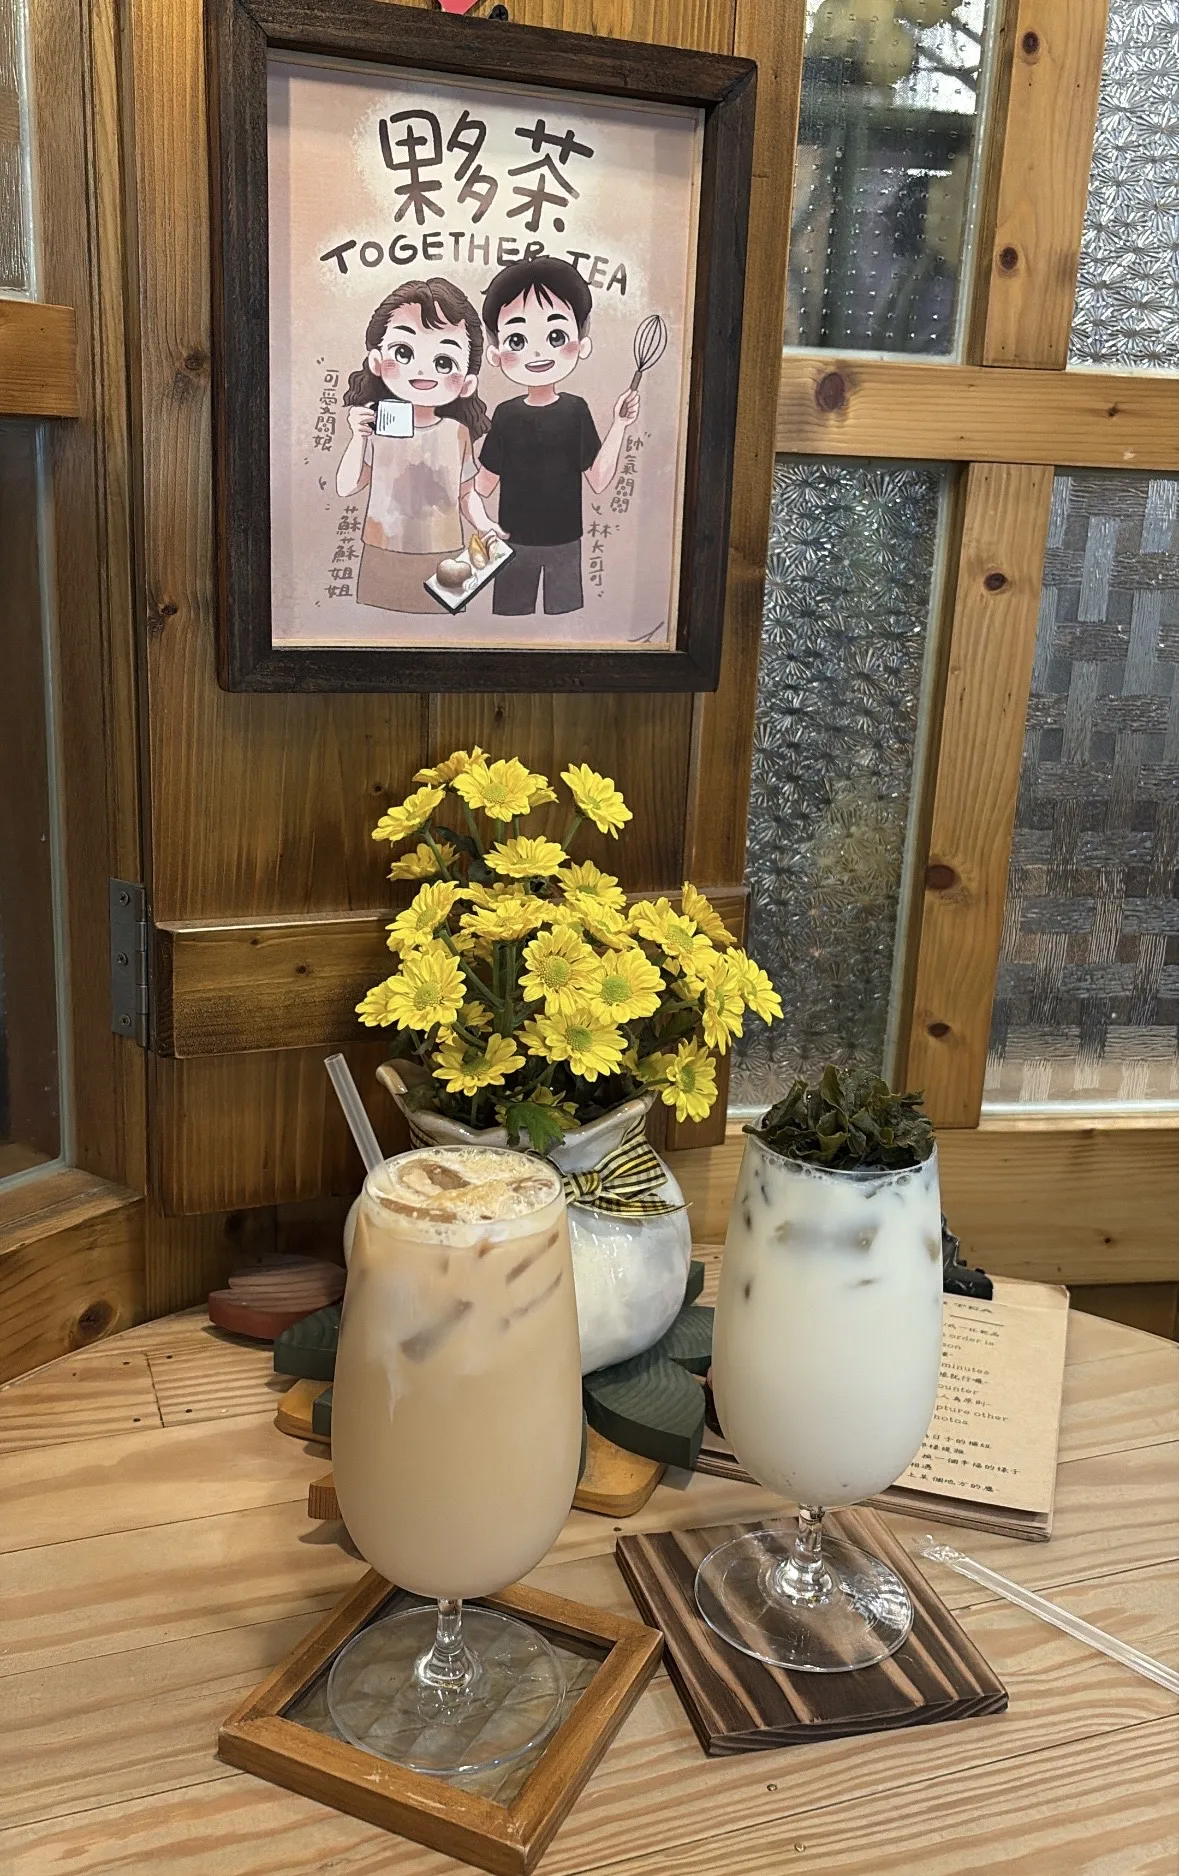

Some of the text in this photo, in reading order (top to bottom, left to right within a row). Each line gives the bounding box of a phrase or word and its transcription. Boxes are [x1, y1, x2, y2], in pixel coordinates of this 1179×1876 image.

[320, 230, 628, 296] TOGETHER TEA
[324, 505, 361, 597] 蘇蘇姐姐
[949, 1333, 982, 1344] order
[942, 1342, 962, 1351] son
[941, 1362, 990, 1375] minutes
[937, 1383, 979, 1395] ounter
[936, 1404, 1009, 1422] pture other
[933, 1414, 969, 1425] hotos
